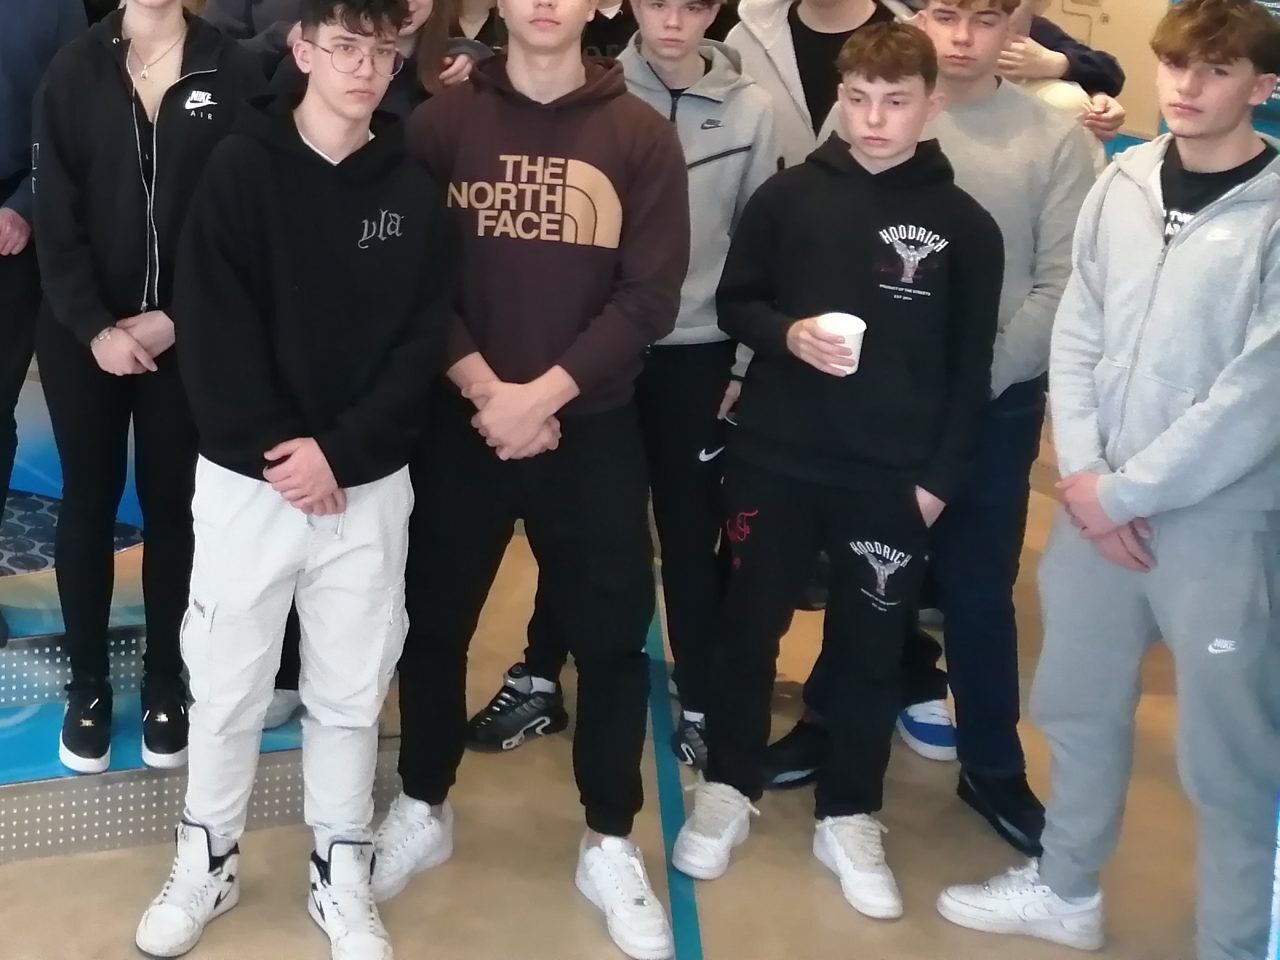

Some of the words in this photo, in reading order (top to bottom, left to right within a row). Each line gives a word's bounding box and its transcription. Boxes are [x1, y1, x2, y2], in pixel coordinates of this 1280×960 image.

[190, 90, 212, 102] NIKE
[190, 110, 213, 120] AIR
[498, 154, 566, 186] THE
[446, 181, 563, 214] NORTH
[477, 209, 562, 242] FACE
[879, 224, 949, 253] HOODRICH
[849, 541, 913, 568] HOODRICH
